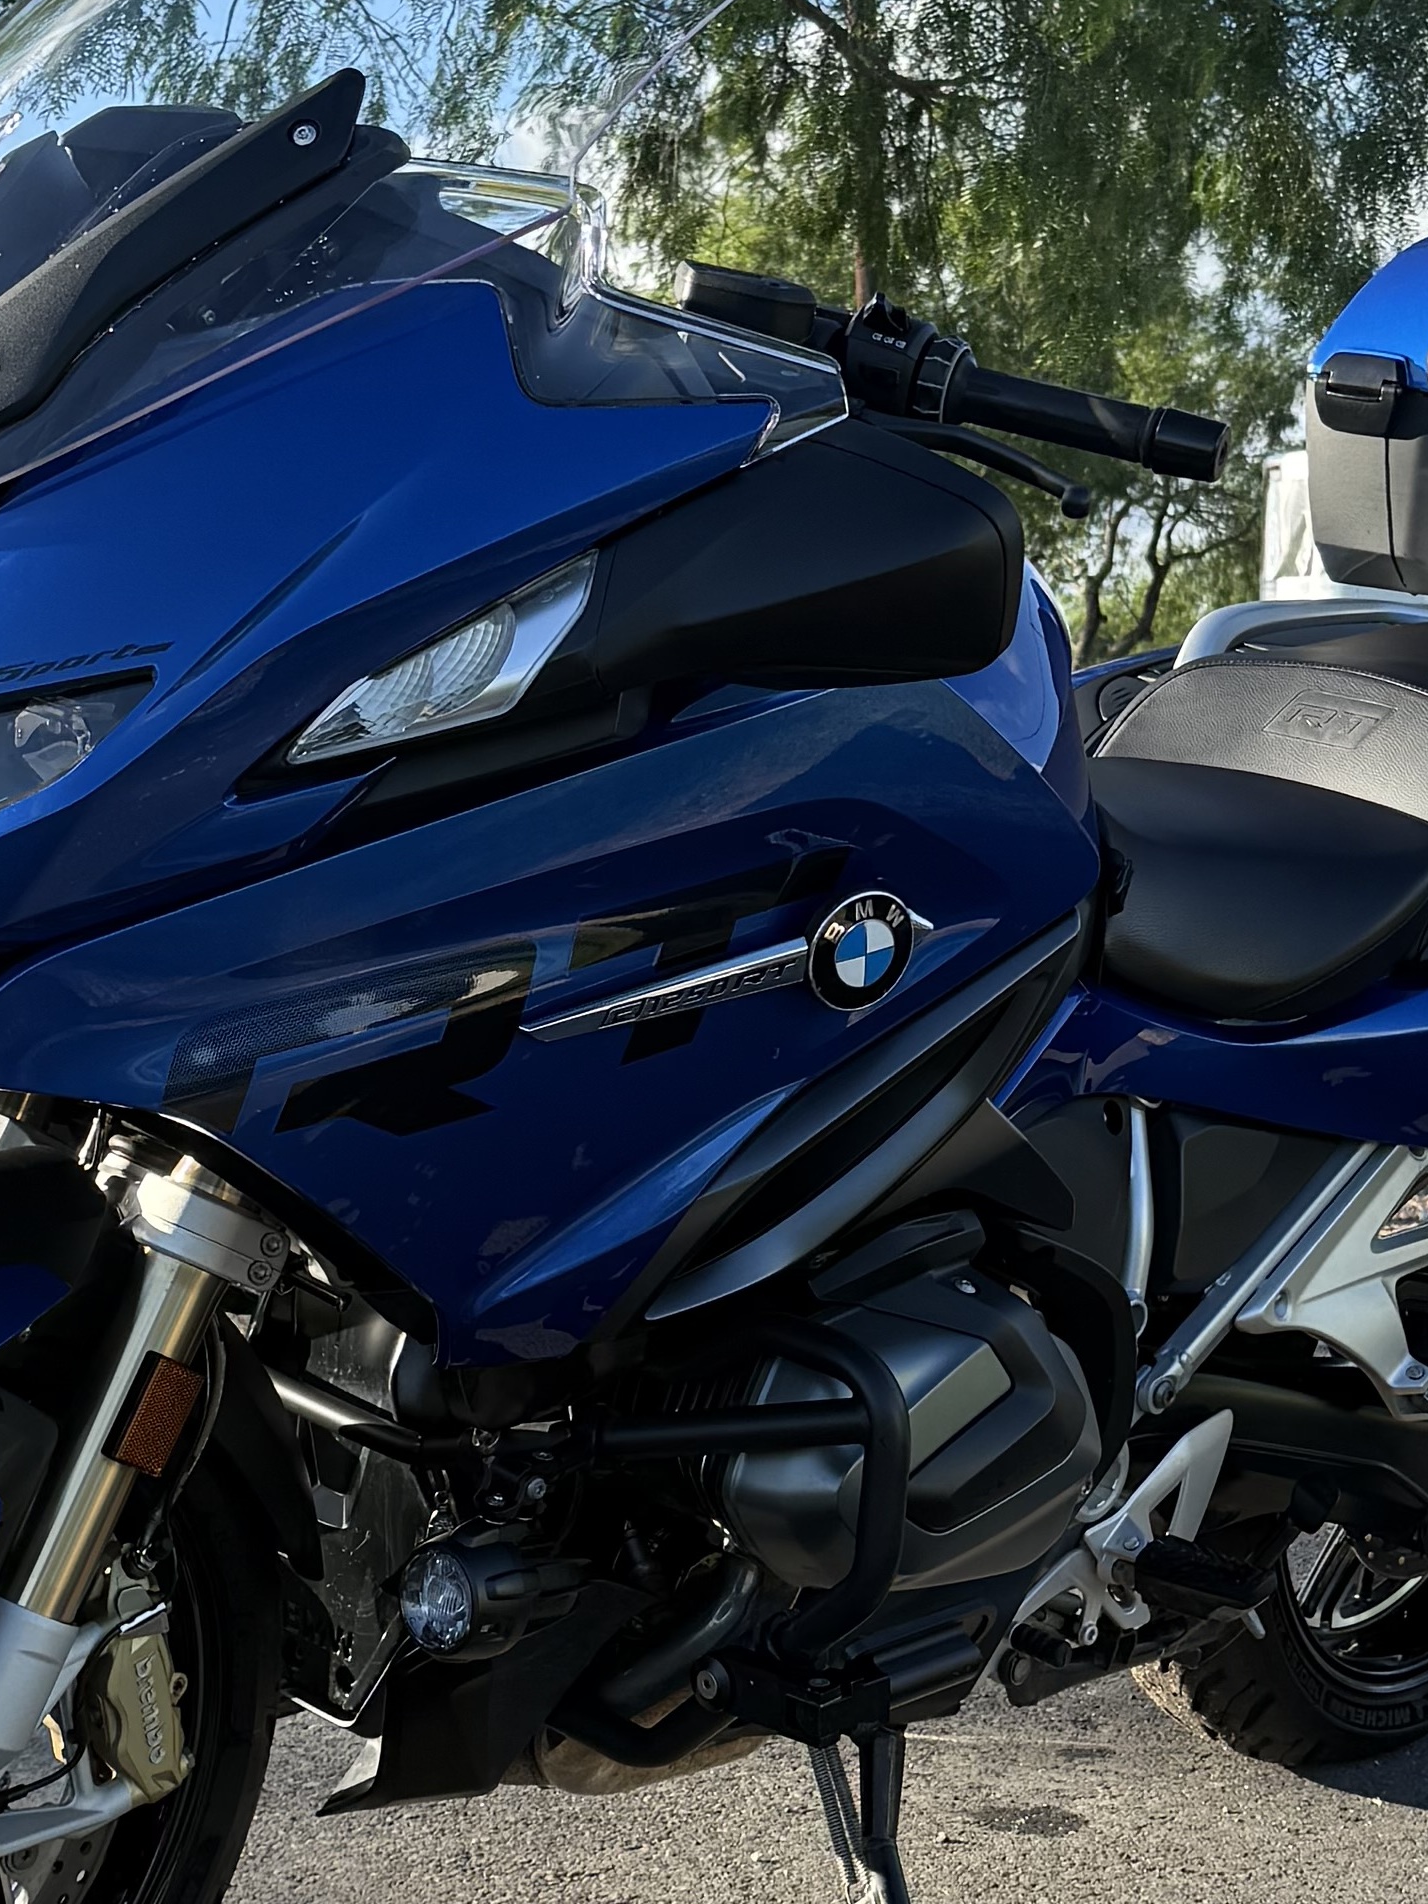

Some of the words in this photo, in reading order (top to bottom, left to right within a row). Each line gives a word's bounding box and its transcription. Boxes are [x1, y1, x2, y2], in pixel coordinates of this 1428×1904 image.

[1283, 702, 1380, 735] RT
[824, 899, 906, 944] BMW
[133, 1650, 167, 1765] brembo
[1327, 1695, 1411, 1728] MICHELIN
